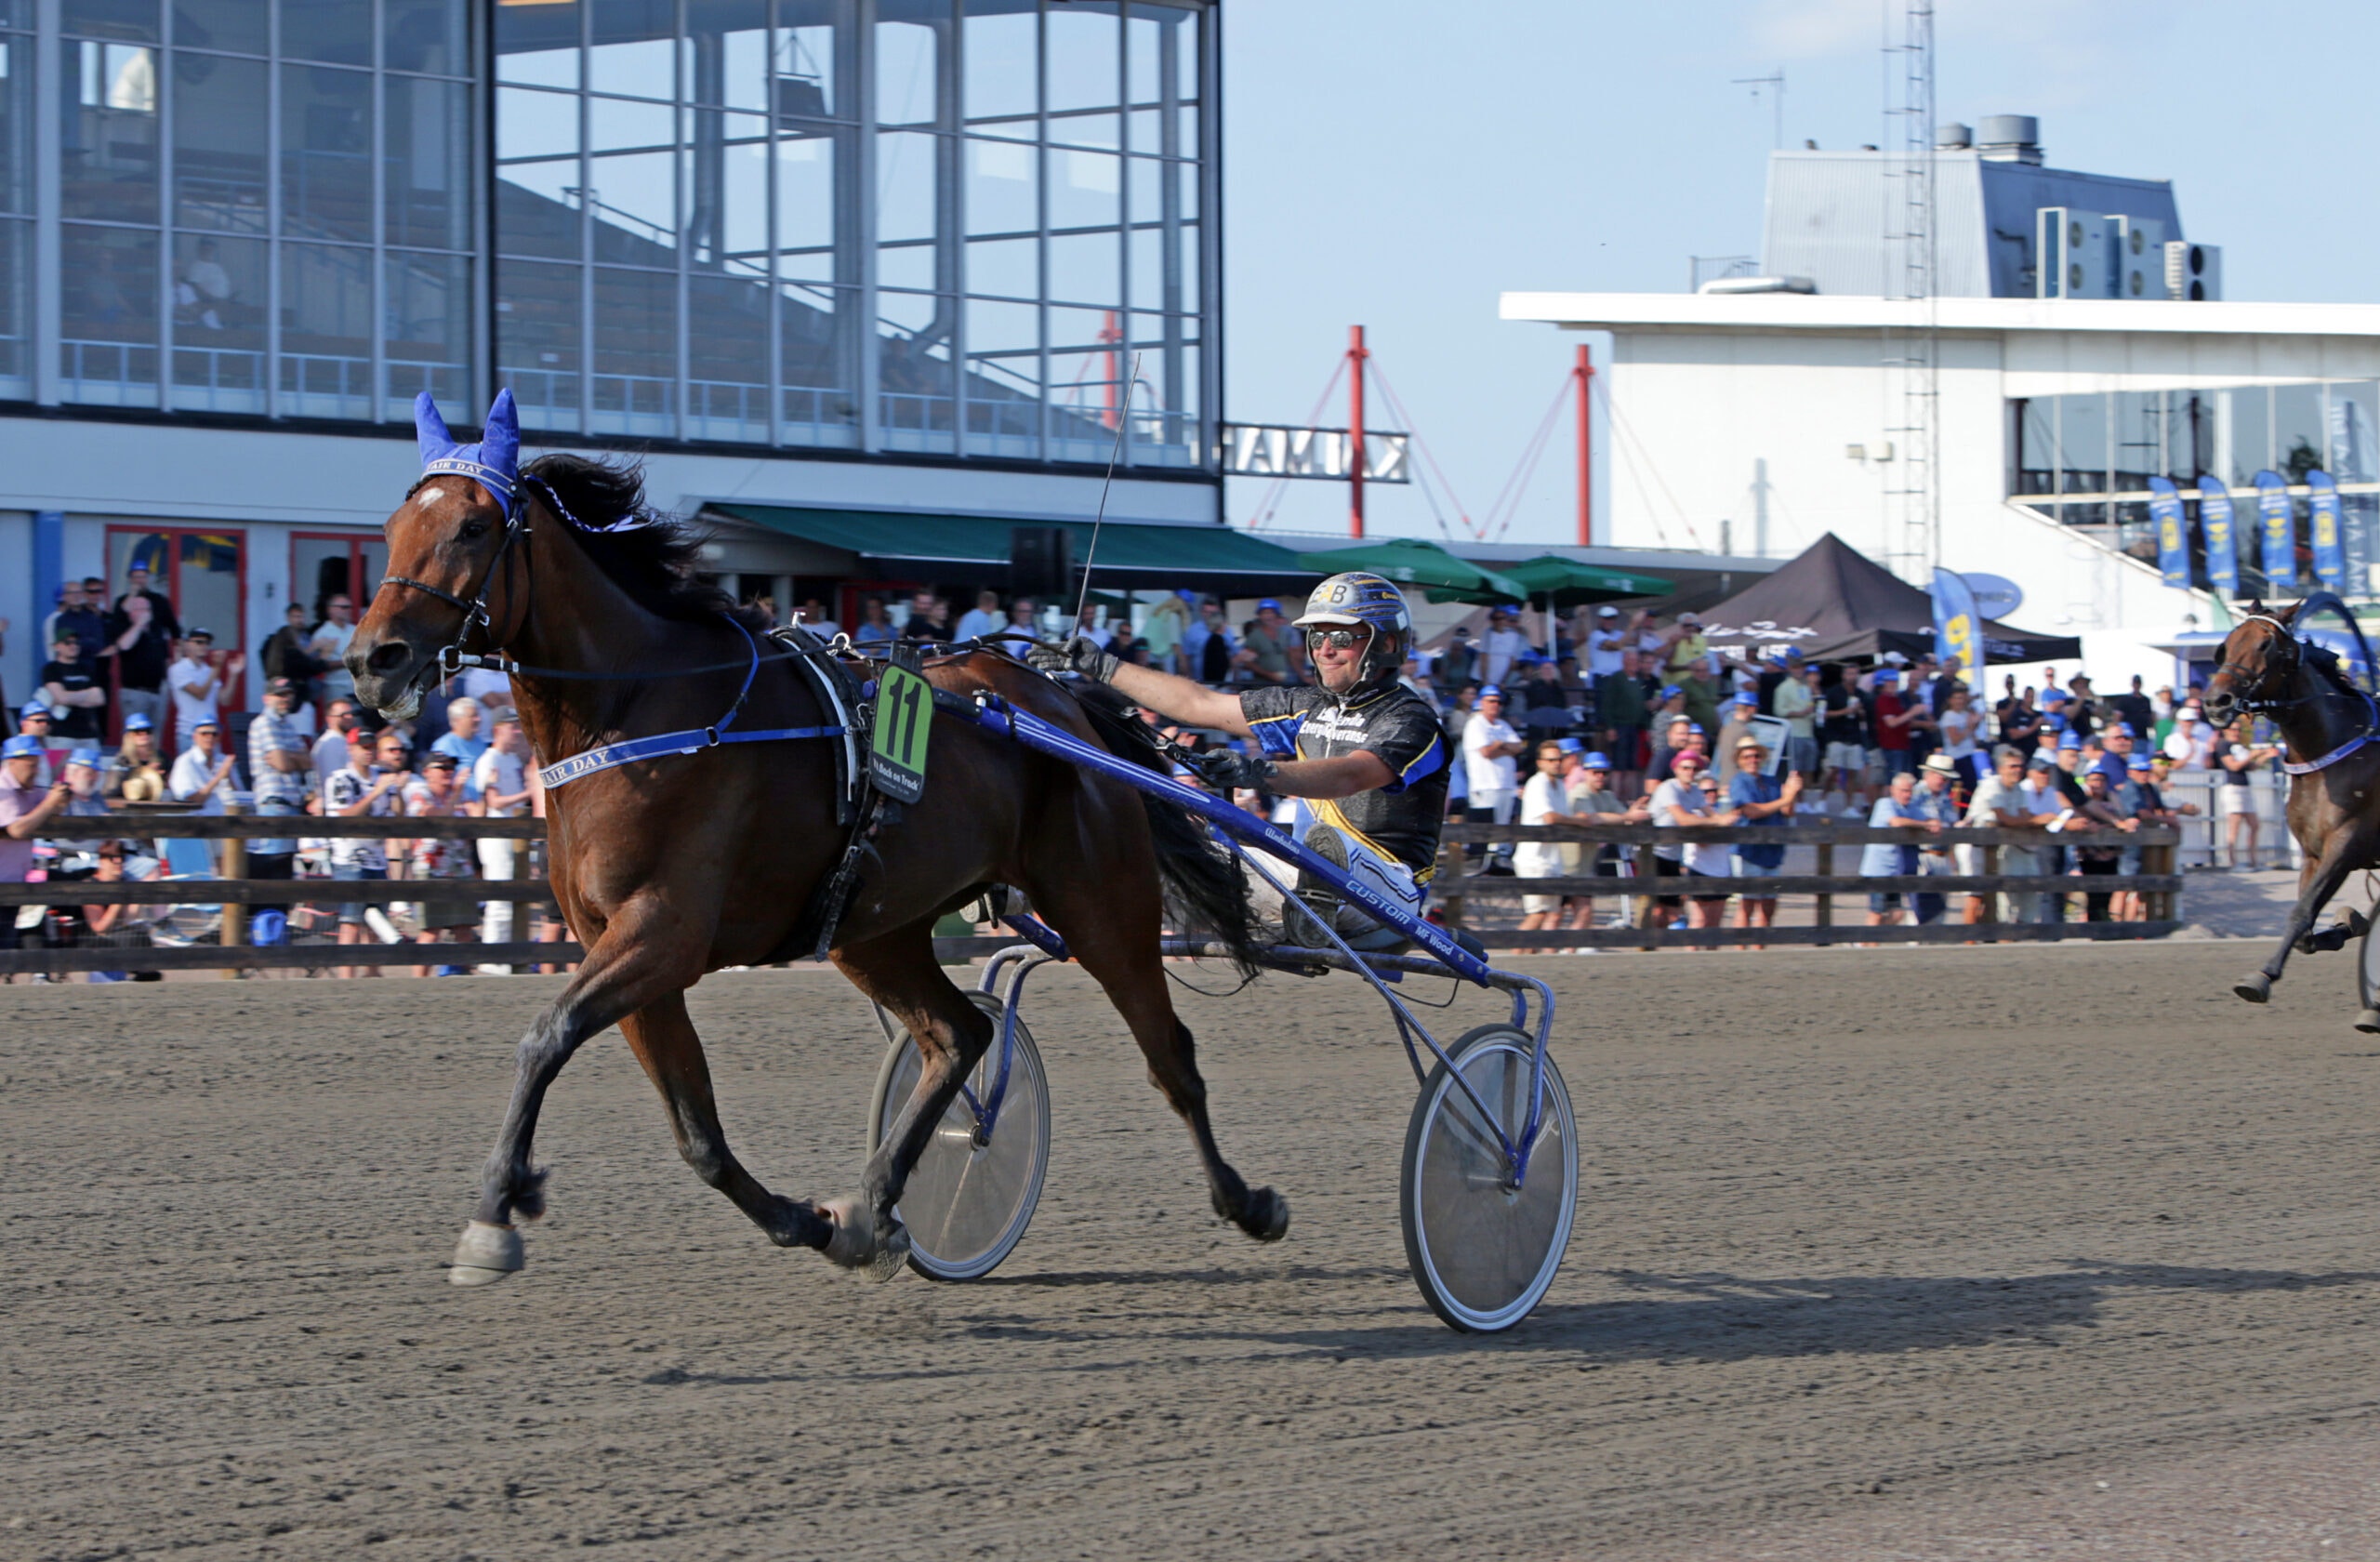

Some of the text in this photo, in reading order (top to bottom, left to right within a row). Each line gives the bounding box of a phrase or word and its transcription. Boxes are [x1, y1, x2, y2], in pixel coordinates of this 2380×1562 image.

[429, 461, 483, 474] AIR DAY
[888, 674, 921, 764] 11
[573, 750, 609, 773] DAY
[1345, 880, 1411, 925] CUSTOM
[1415, 925, 1454, 956] MF Wood
